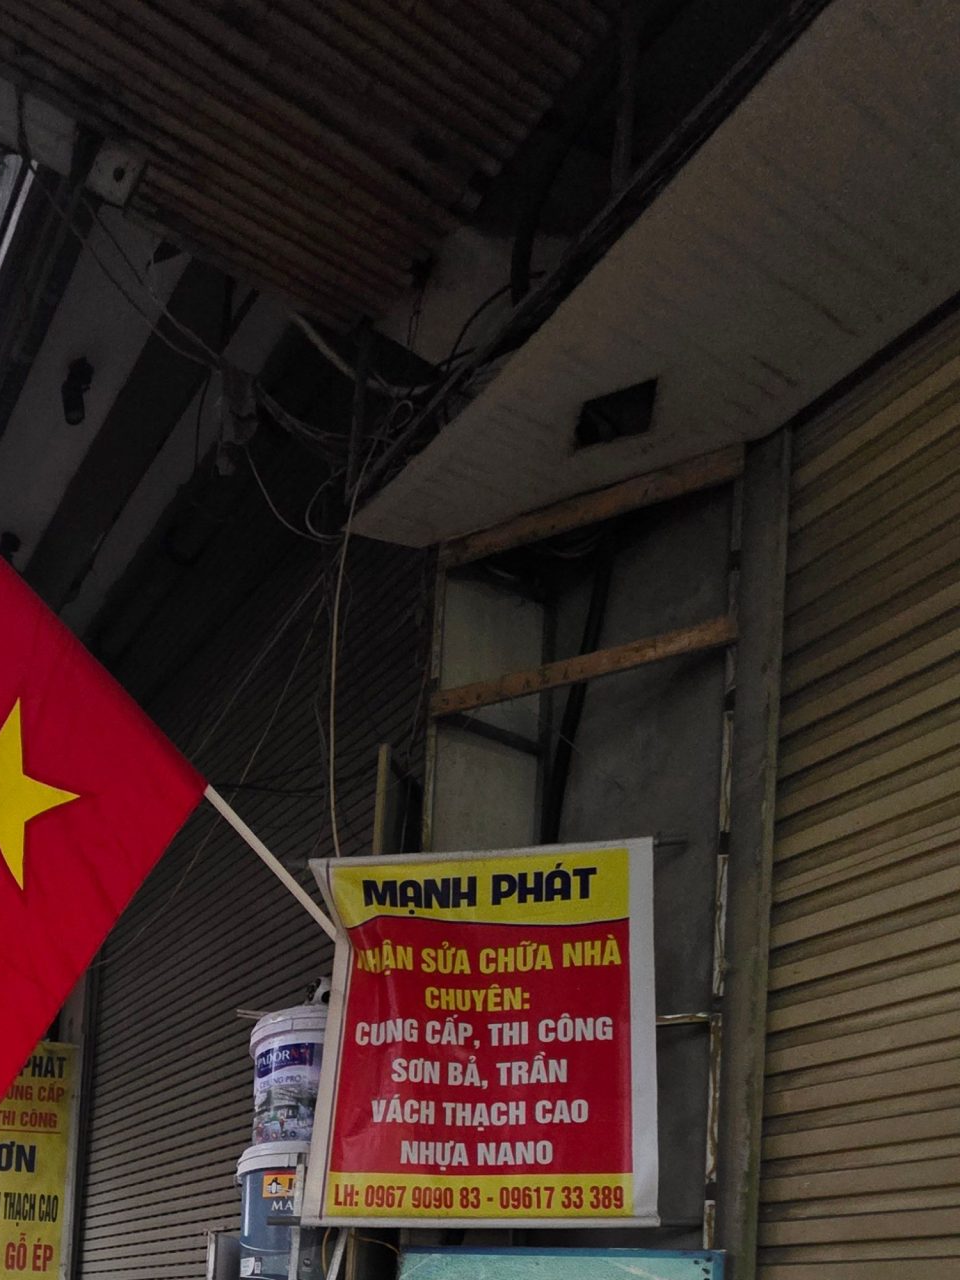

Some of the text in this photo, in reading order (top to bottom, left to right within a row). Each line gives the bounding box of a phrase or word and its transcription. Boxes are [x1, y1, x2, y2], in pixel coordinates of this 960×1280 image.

[362, 862, 597, 915] MẠNH PHÁT
[358, 934, 622, 976] NHẬN SỬA CHỮA NHÀ
[425, 984, 530, 1012] CHUYÊN:
[355, 1013, 613, 1050] CUNG CẤP, THI CÔNG
[391, 1051, 568, 1090] SƠN BẢ, TRẦN
[6, 1082, 65, 1104] UNG CẤP
[20, 1110, 57, 1128] CÔNG
[371, 1094, 589, 1132] VÁCH THẠCH CAO
[400, 1140, 553, 1171] NHỰA NANO
[4, 1191, 36, 1227] THẠCH
[38, 1193, 59, 1223] CAO
[334, 1183, 359, 1208] LH:
[364, 1184, 407, 1208] 0967
[411, 1186, 453, 1210] 9090
[459, 1187, 481, 1209] 83
[499, 1186, 555, 1209] 09617
[560, 1186, 584, 1210] 33
[590, 1186, 624, 1209] 389
[4, 1232, 27, 1271] GỖ
[31, 1238, 53, 1272] ÉP
